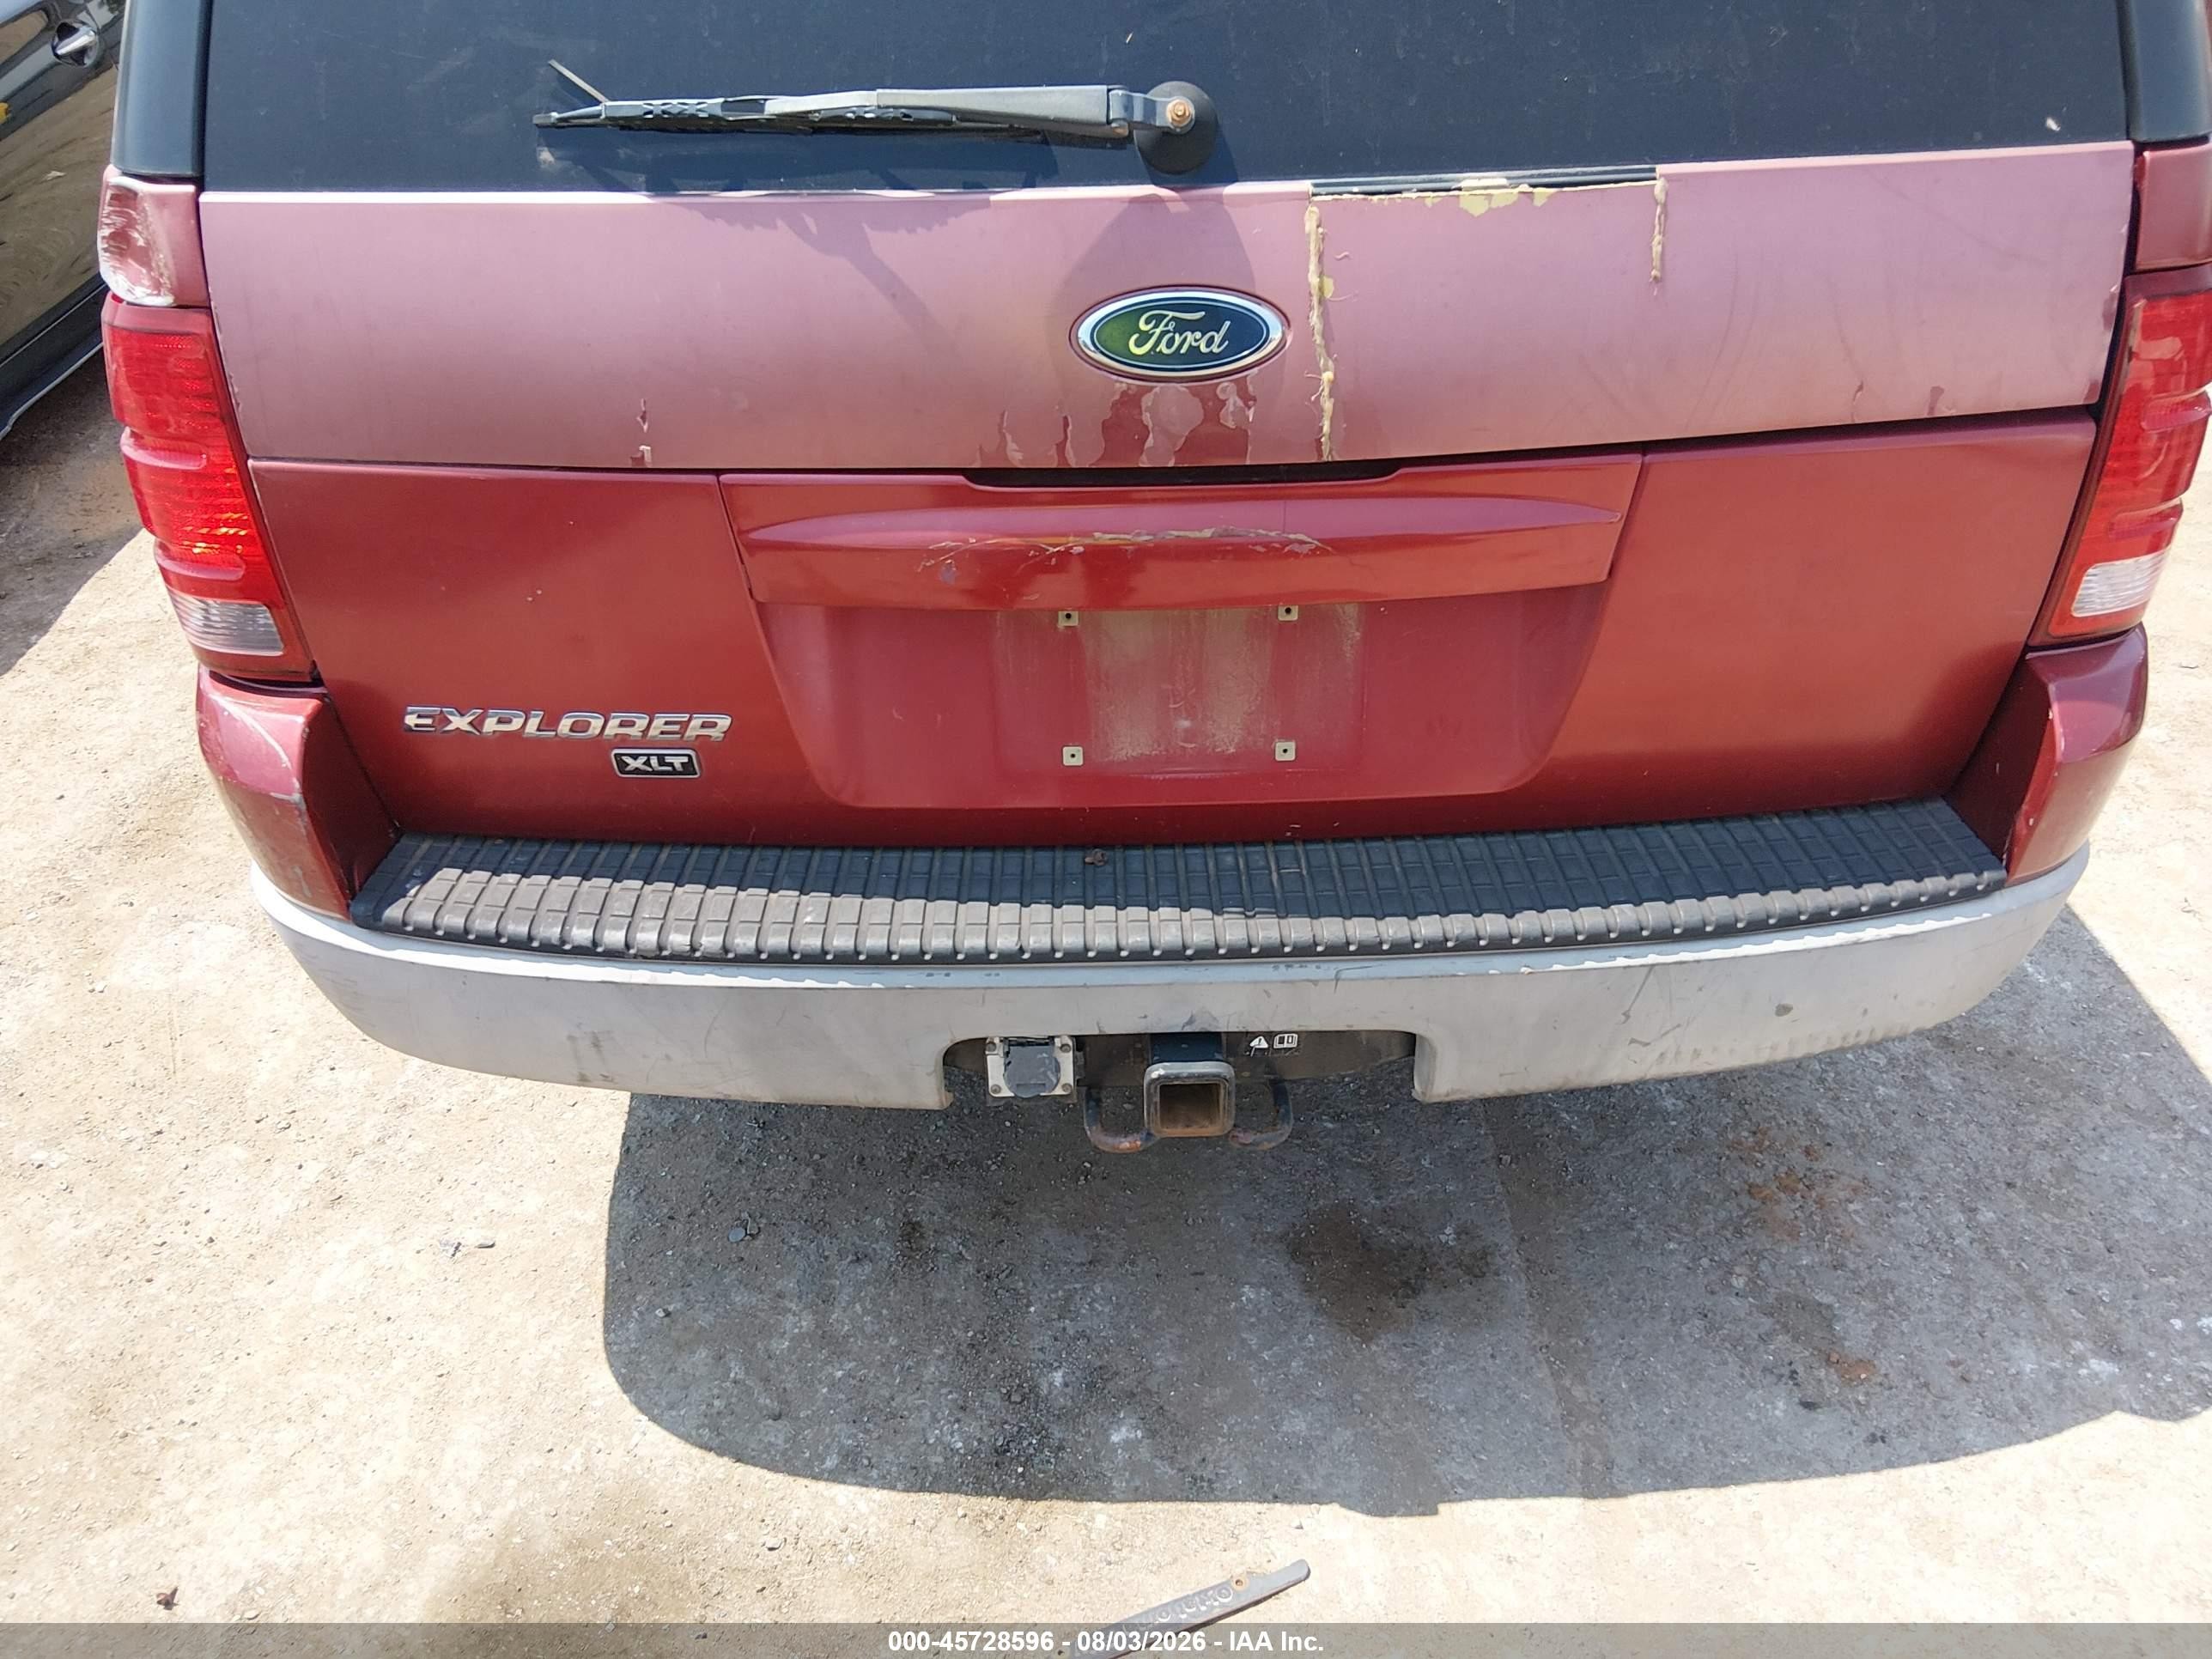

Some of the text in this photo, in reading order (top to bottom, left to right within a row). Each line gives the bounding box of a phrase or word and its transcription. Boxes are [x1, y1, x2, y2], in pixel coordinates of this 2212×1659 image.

[1127, 309, 1231, 356] Ford
[404, 706, 732, 742] EXPLORER
[623, 755, 690, 772] XLT
